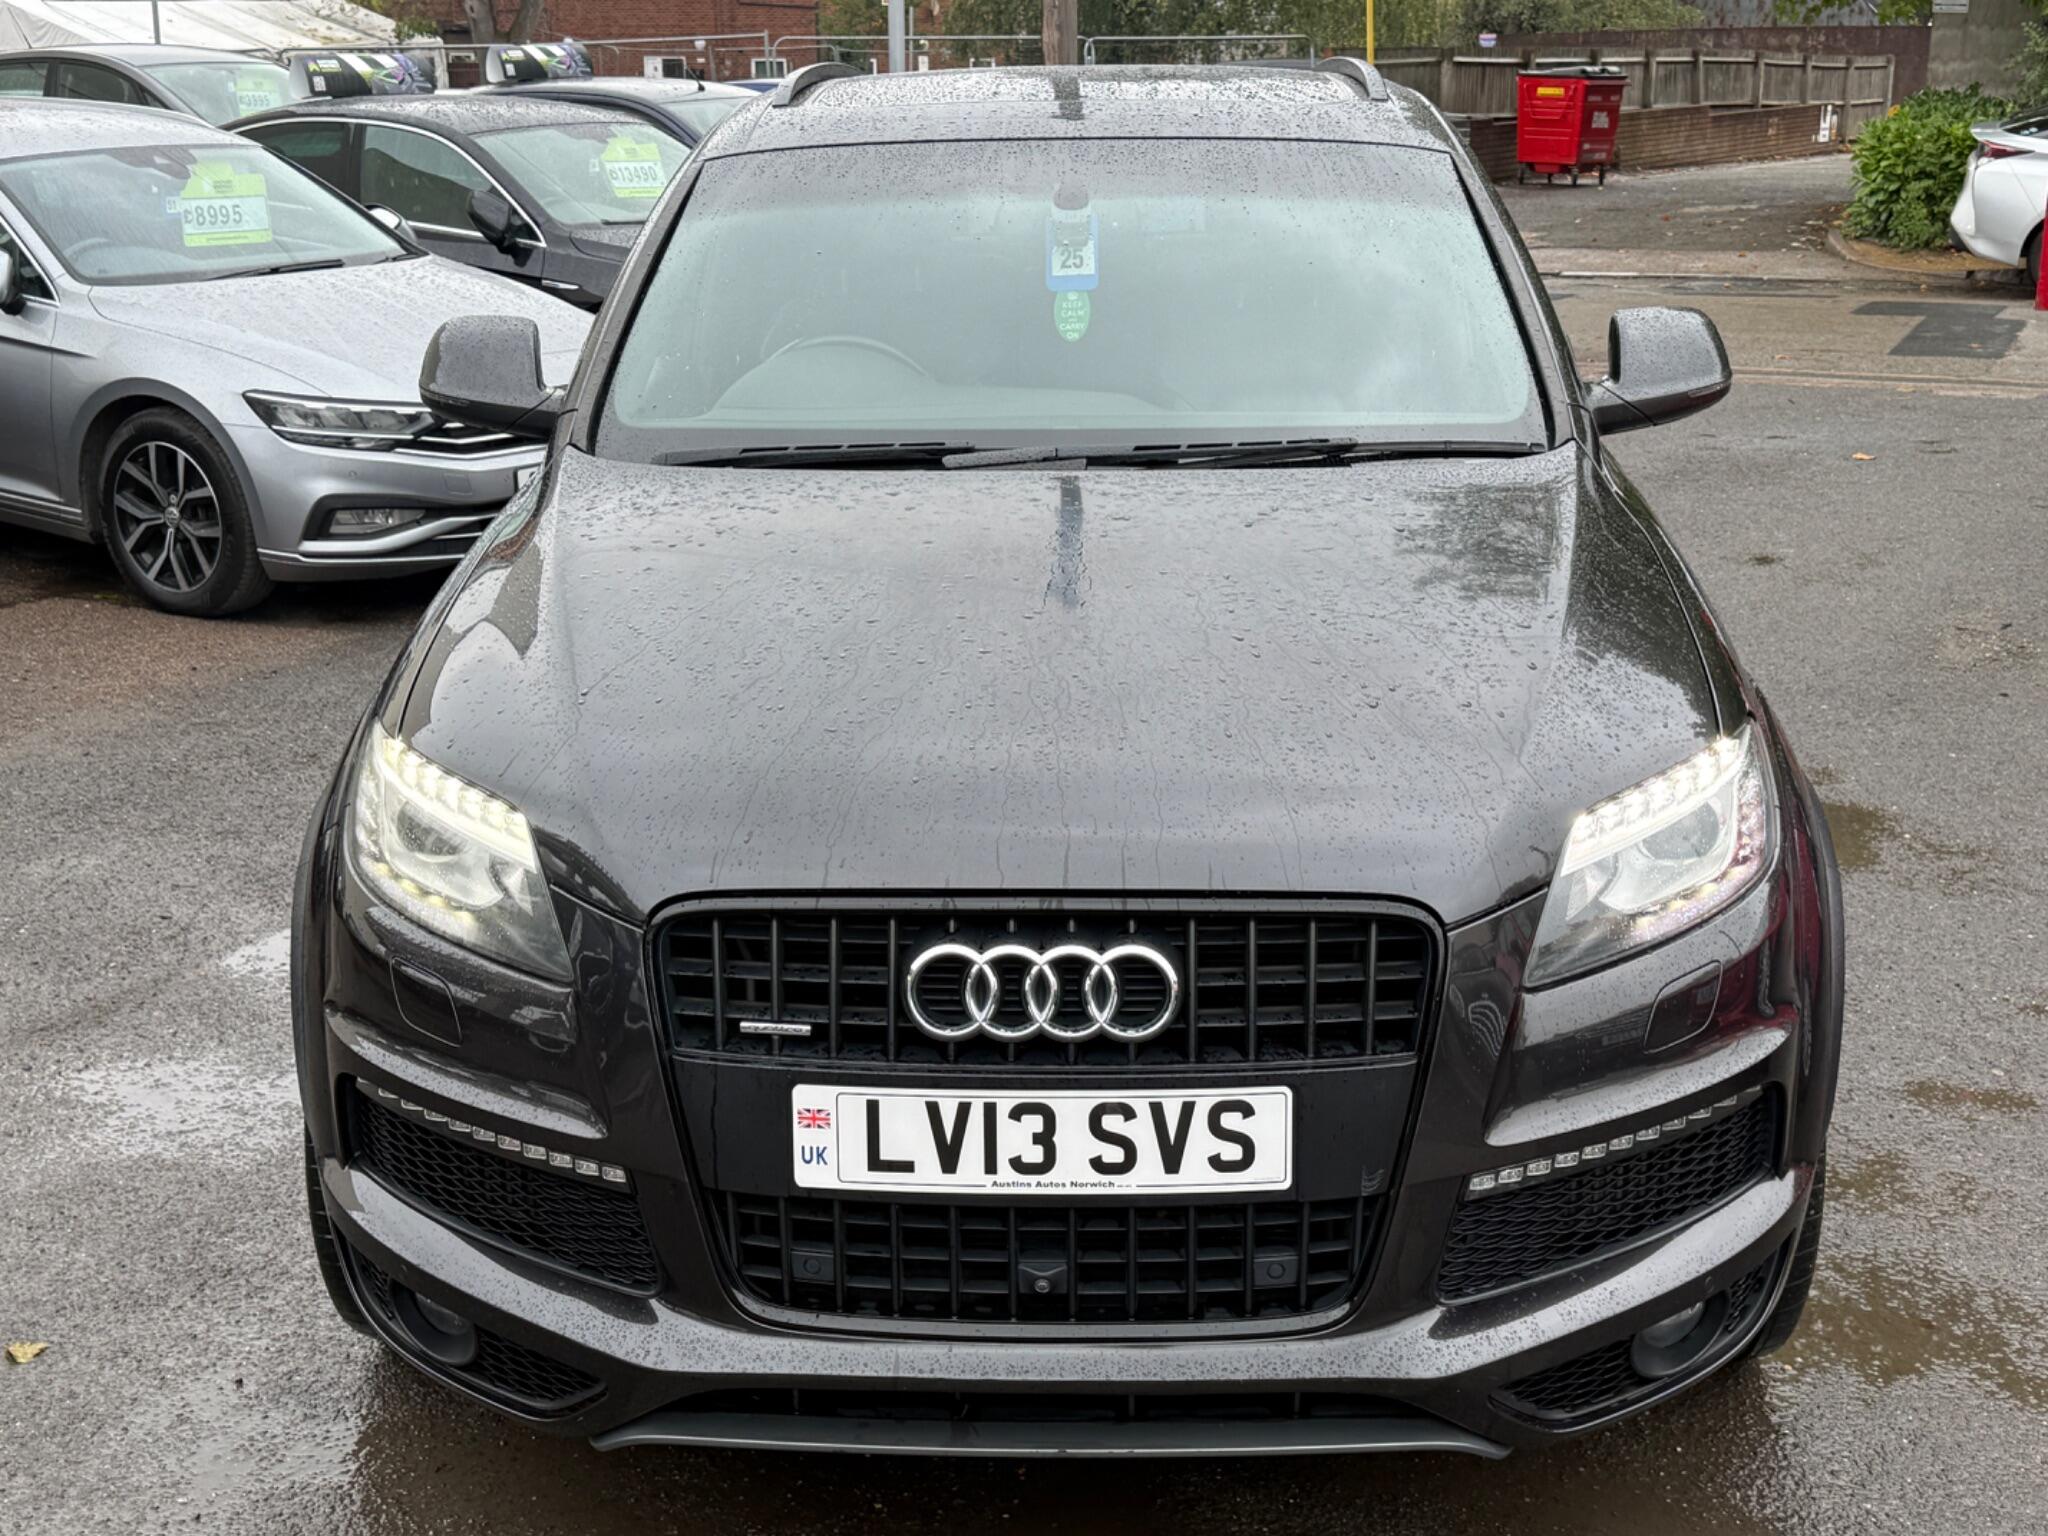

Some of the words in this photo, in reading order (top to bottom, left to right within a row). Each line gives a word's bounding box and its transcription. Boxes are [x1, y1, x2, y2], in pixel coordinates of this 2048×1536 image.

[184, 204, 242, 226] £8995
[1060, 249, 1084, 269] 25
[1066, 332, 1079, 340] ON
[866, 1099, 1057, 1175] LV13
[1088, 1099, 1256, 1175] SVS
[801, 1145, 828, 1165] UK
[991, 1180, 1031, 1188] Austins
[1035, 1180, 1066, 1188] Autos
[1070, 1180, 1115, 1188] Norwich
